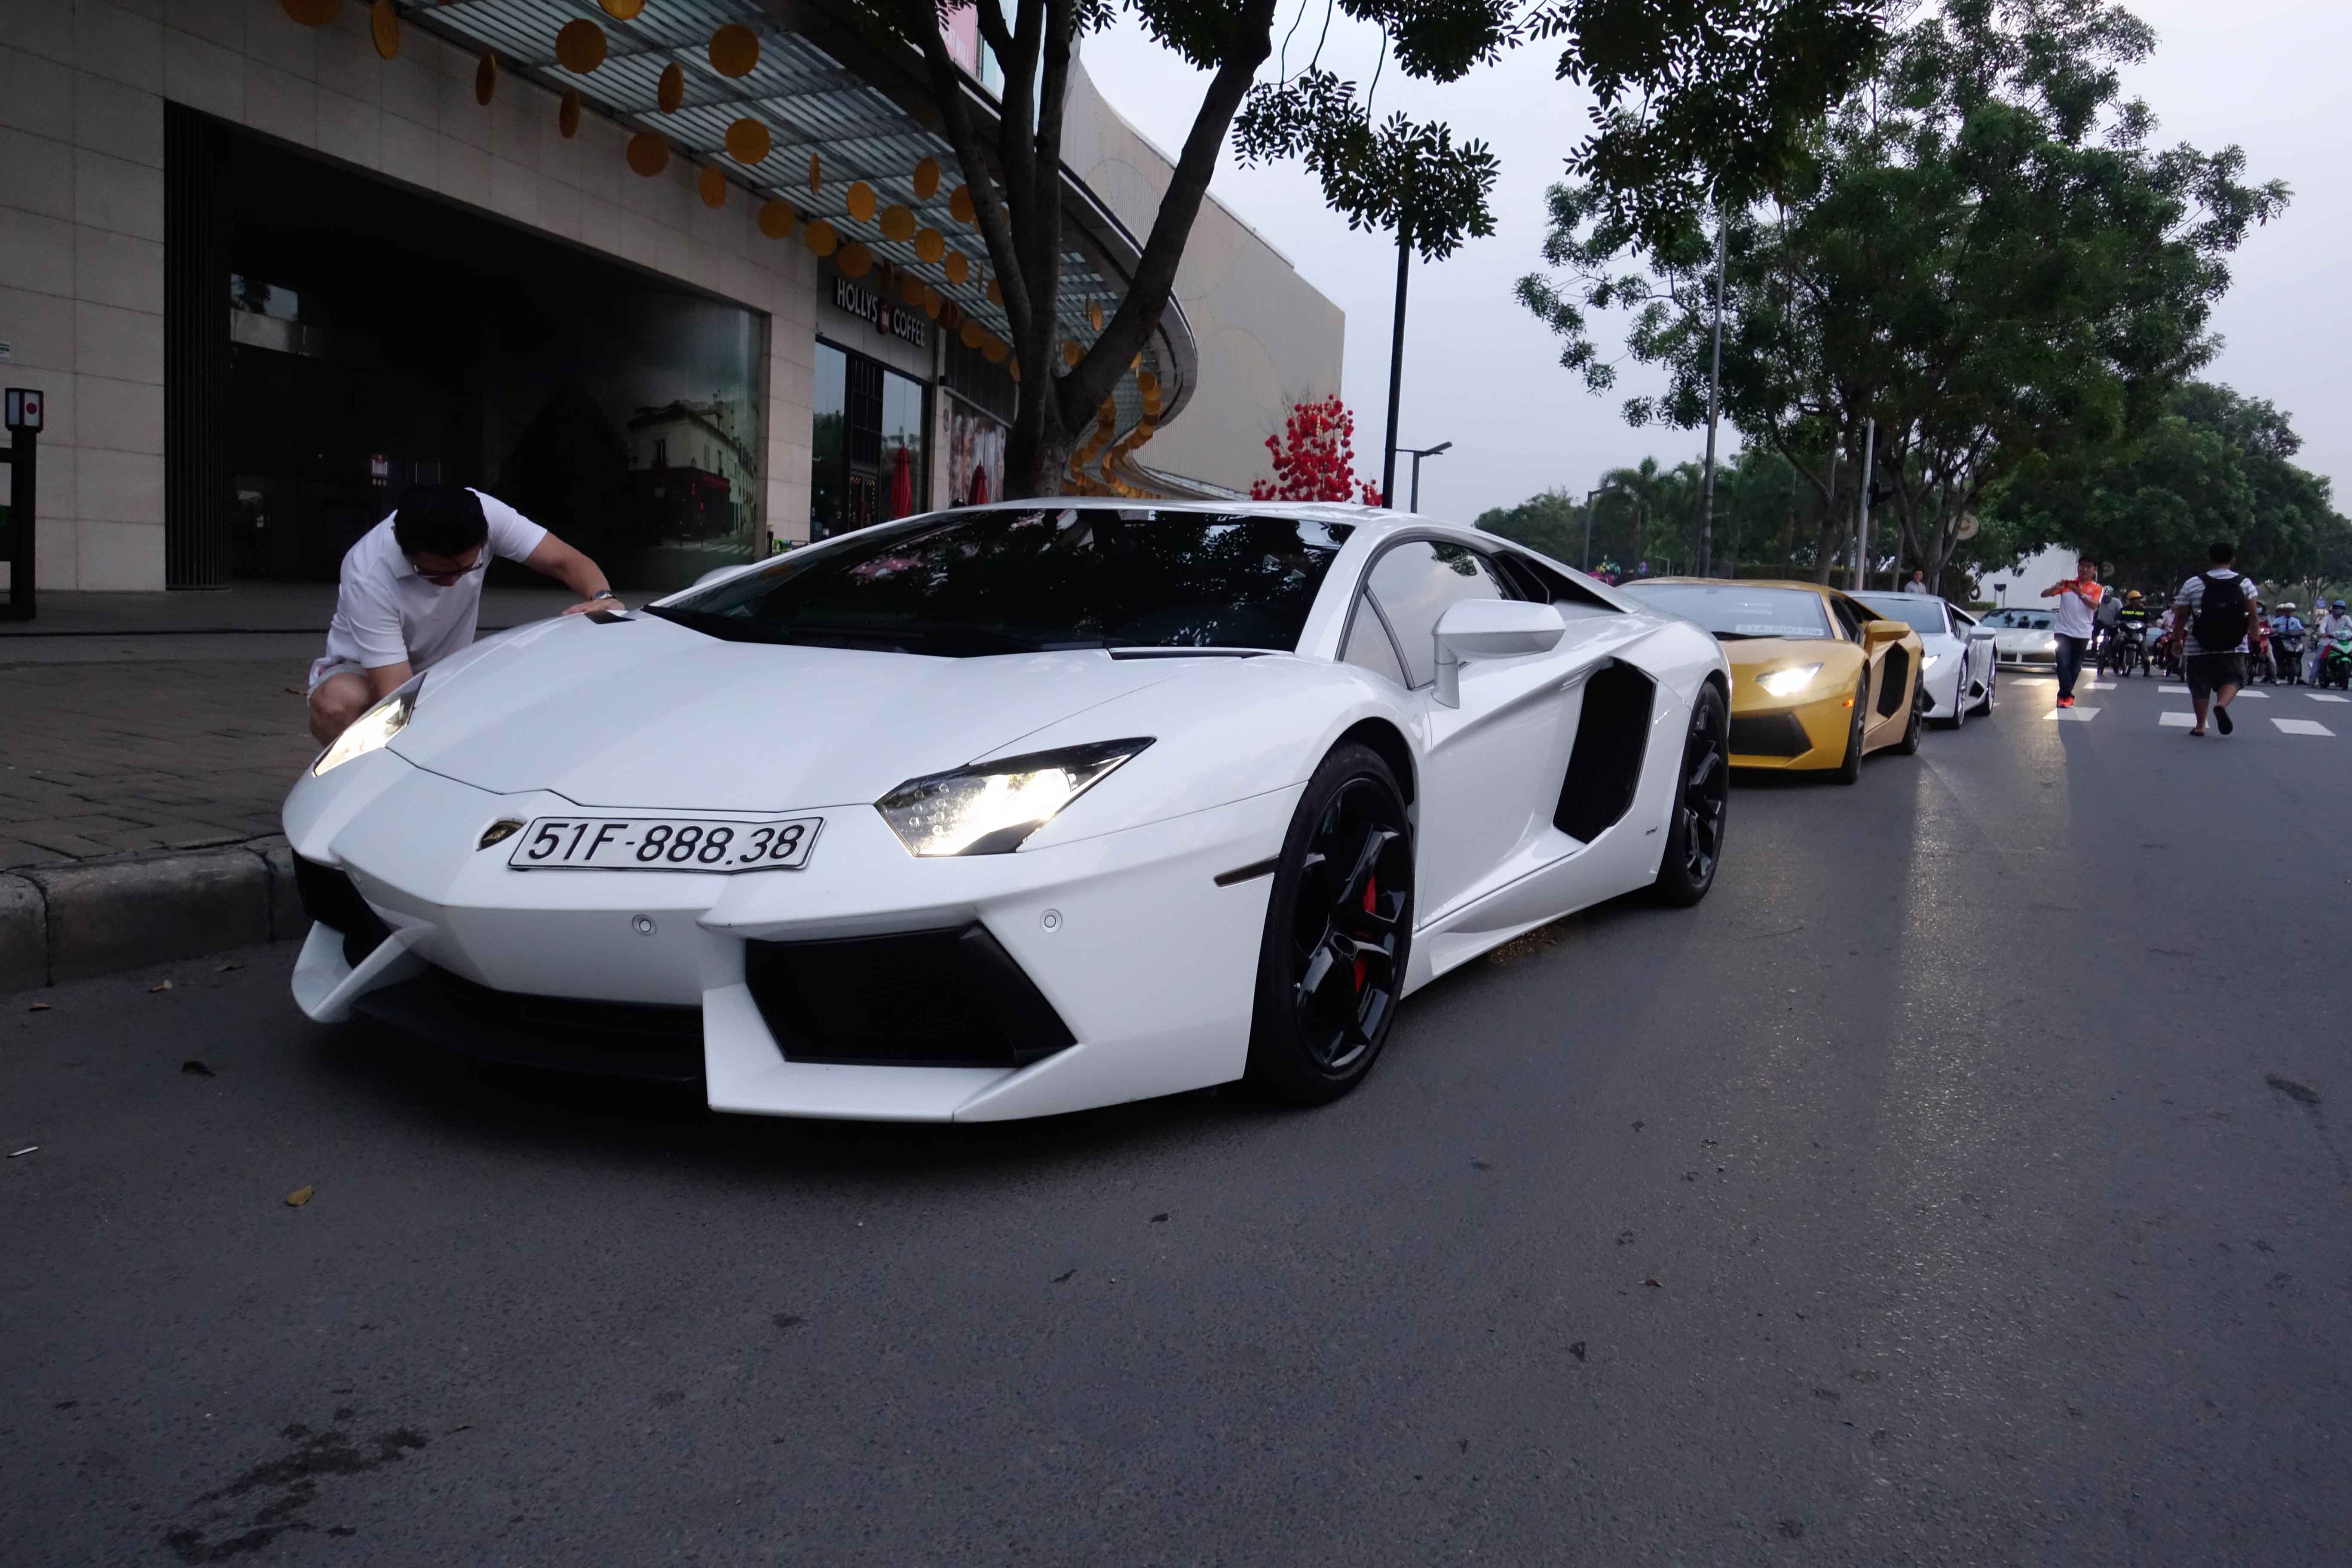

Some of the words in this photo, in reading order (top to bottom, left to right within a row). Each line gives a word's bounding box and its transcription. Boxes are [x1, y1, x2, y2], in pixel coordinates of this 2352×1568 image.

[837, 279, 878, 323] HOLLYS
[894, 307, 925, 347] COFFEE
[528, 823, 805, 865] 51F-888.38
